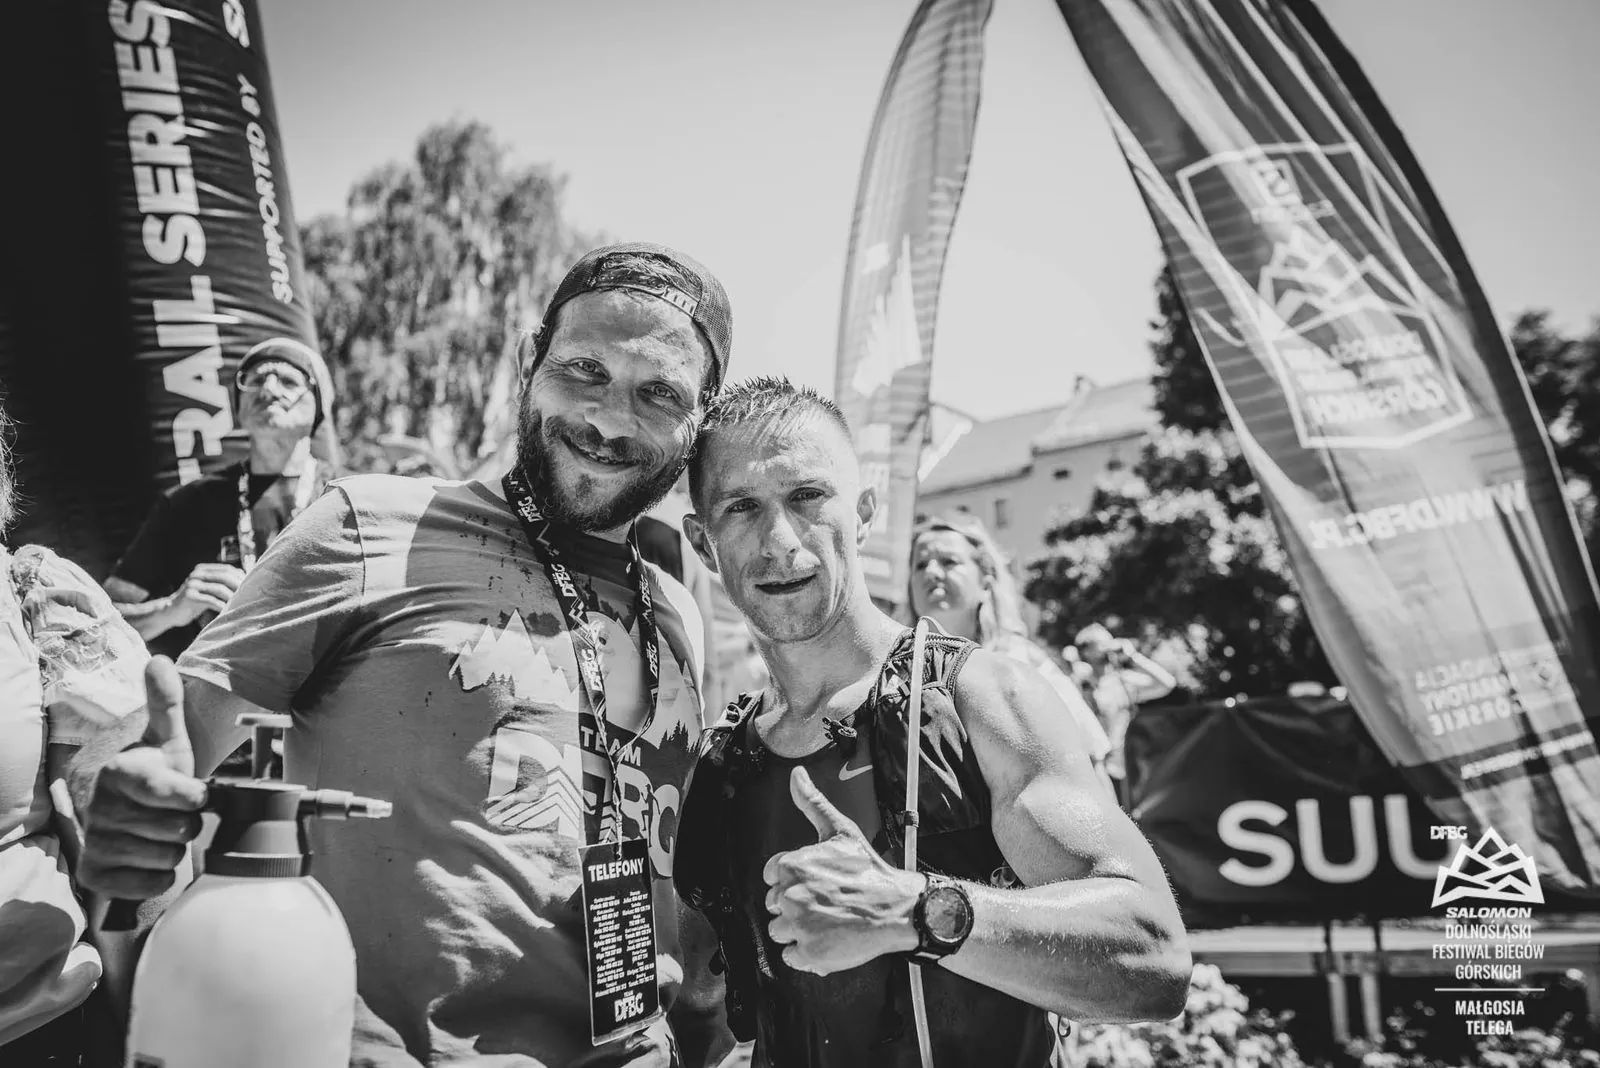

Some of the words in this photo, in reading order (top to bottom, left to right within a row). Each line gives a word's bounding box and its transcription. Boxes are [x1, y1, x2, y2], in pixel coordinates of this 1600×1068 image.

[108, 0, 207, 267] SERIES
[237, 72, 261, 118] BY
[245, 121, 293, 304] SUPPORTED
[588, 858, 645, 883] TELEFONY
